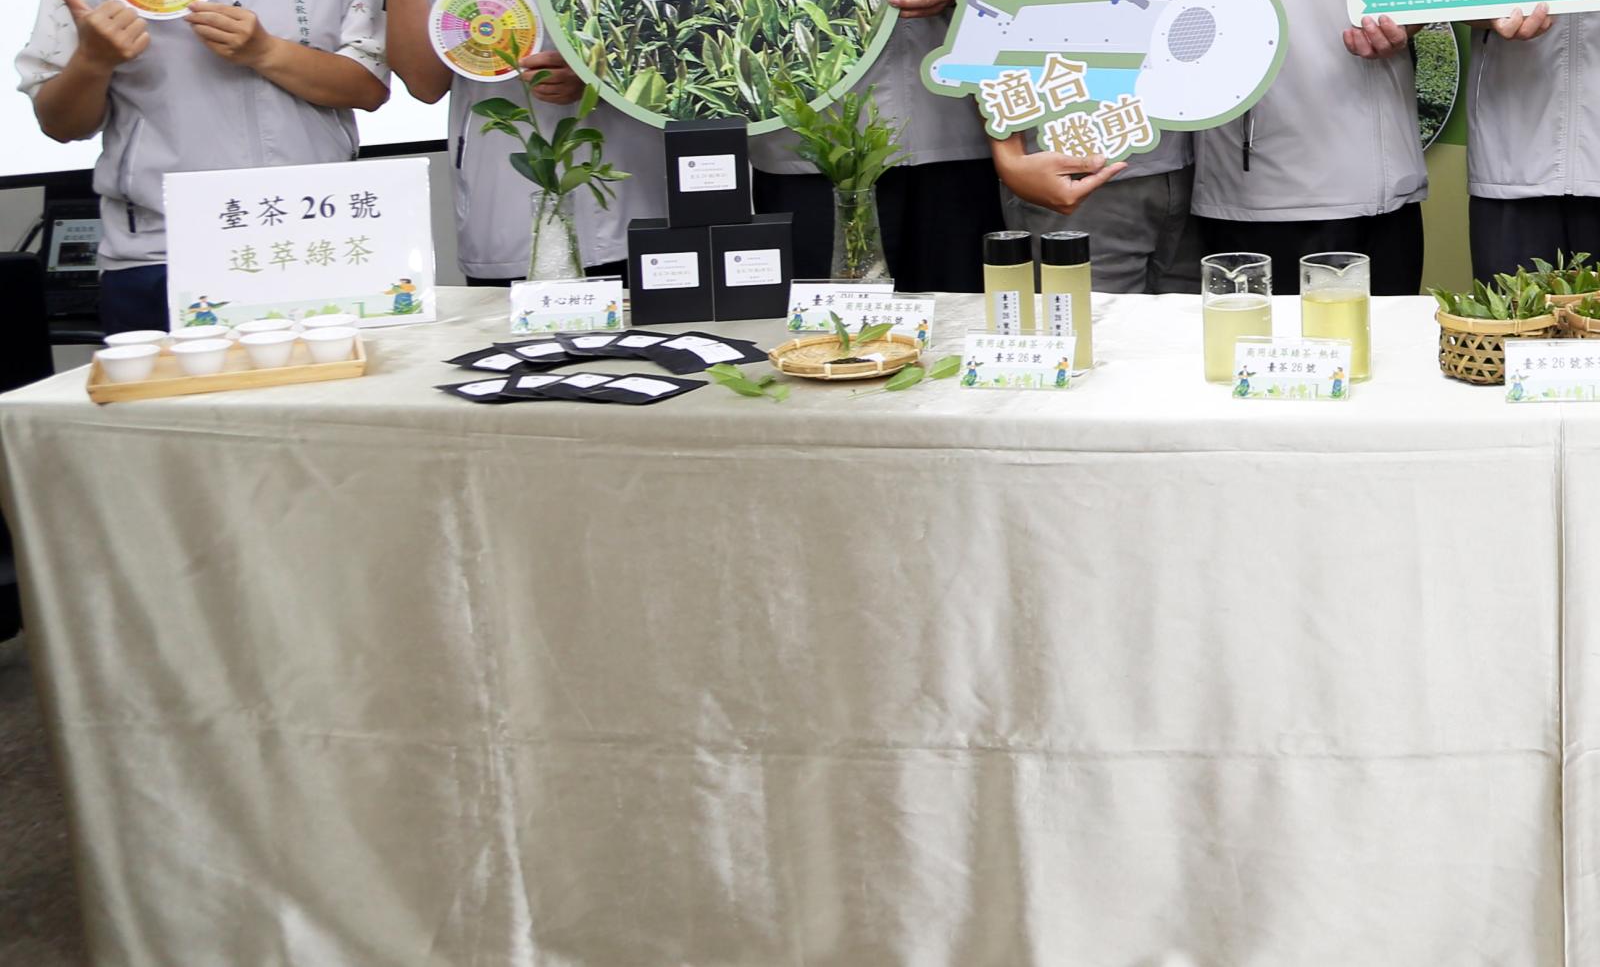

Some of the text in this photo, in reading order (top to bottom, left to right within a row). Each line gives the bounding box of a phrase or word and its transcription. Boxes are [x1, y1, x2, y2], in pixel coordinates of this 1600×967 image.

[983, 56, 1087, 129] 適合
[1046, 97, 1150, 158] 機剪
[229, 235, 374, 273] 速萃綠茶
